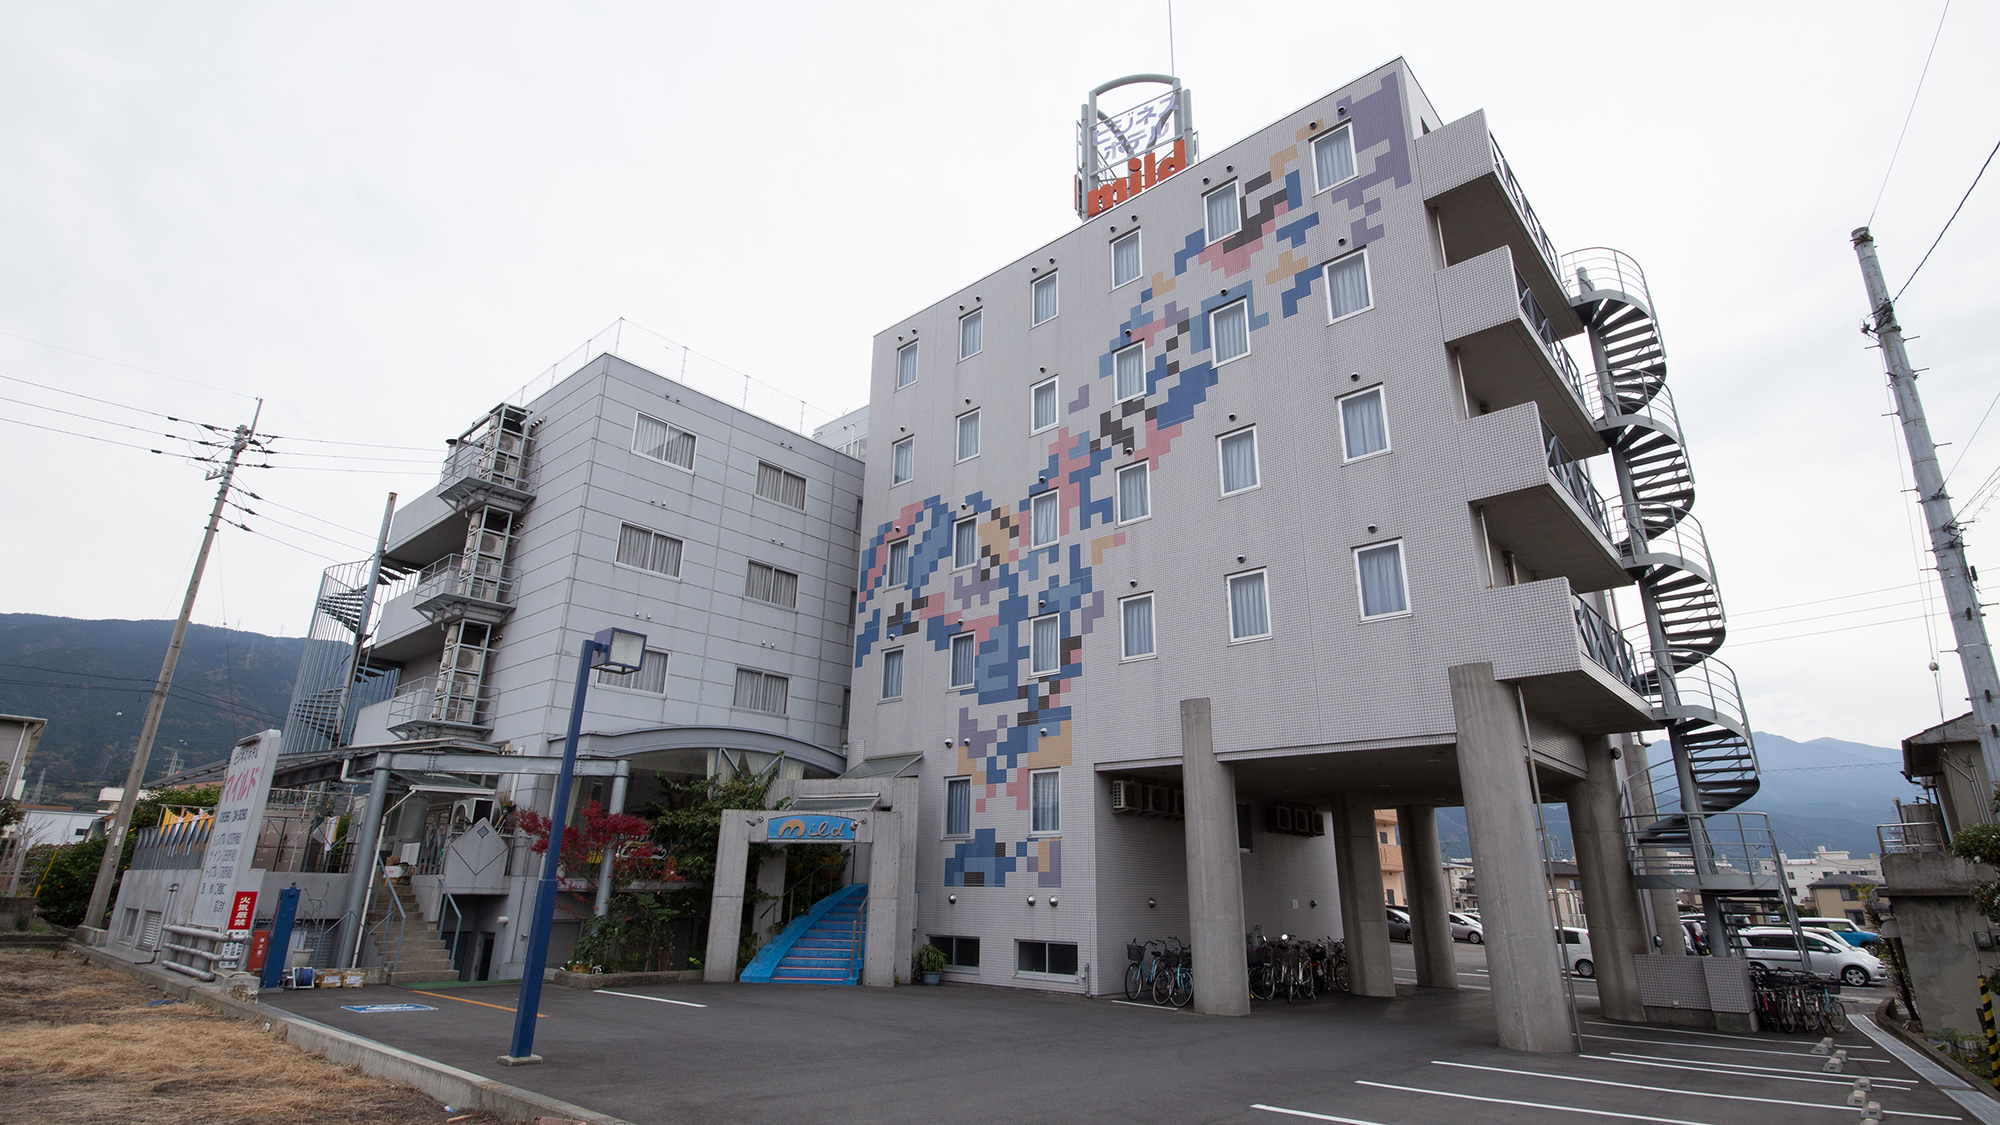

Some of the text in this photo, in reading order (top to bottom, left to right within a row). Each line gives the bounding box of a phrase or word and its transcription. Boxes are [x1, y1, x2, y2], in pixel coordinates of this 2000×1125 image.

[1093, 94, 1179, 147] ビジネス
[1103, 121, 1170, 161] ホテル
[1087, 139, 1187, 219] mild
[225, 766, 260, 804] マイルド
